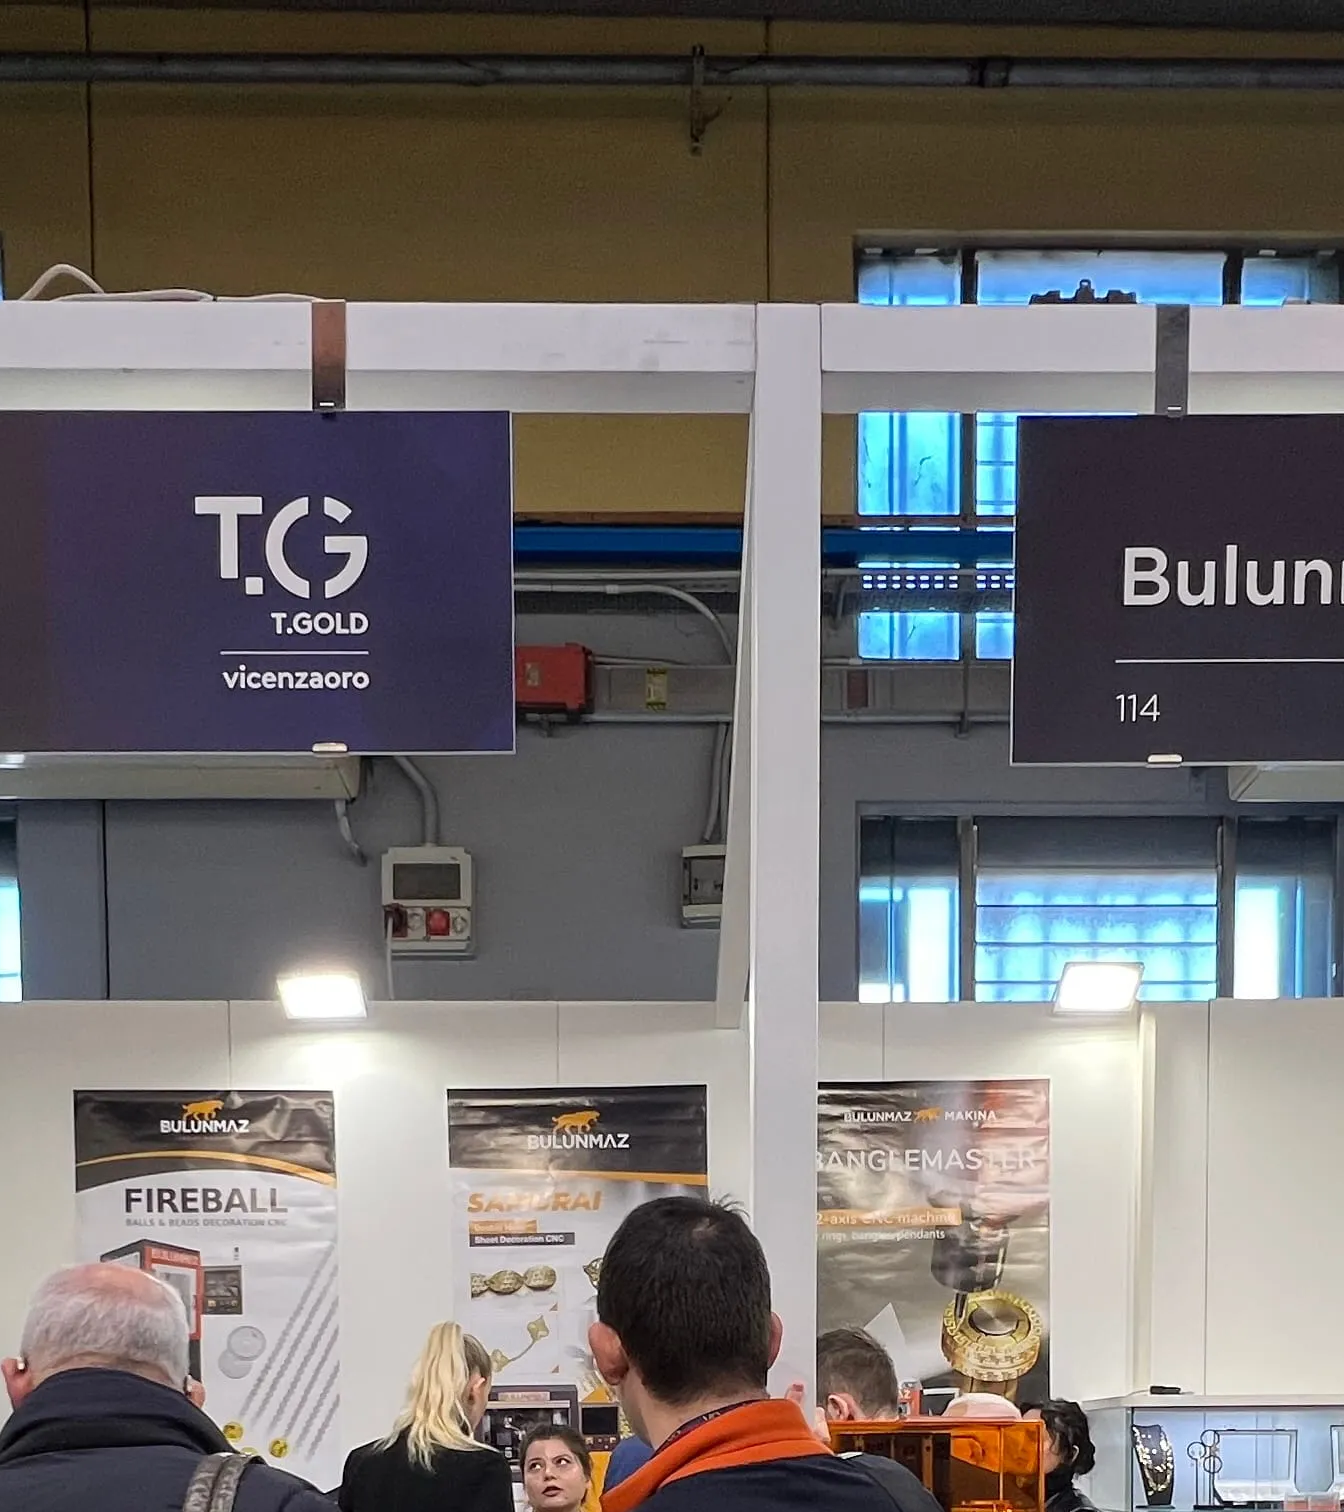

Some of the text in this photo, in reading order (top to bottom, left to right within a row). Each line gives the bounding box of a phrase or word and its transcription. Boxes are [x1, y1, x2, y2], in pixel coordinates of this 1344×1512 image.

[270, 612, 369, 635] T.GOLD
[223, 665, 370, 691] vicenzaoro
[1115, 693, 1160, 722] 114
[844, 1109, 997, 1123] BULUNMAZ MAKINA
[160, 1119, 250, 1134] BULUNMAZ
[527, 1133, 630, 1150] BULUNMAZ
[125, 1187, 288, 1214] FIREBALL
[126, 1218, 155, 1227] BALLS
[169, 1218, 200, 1227] BEADS
[203, 1218, 265, 1227] DECORATION
